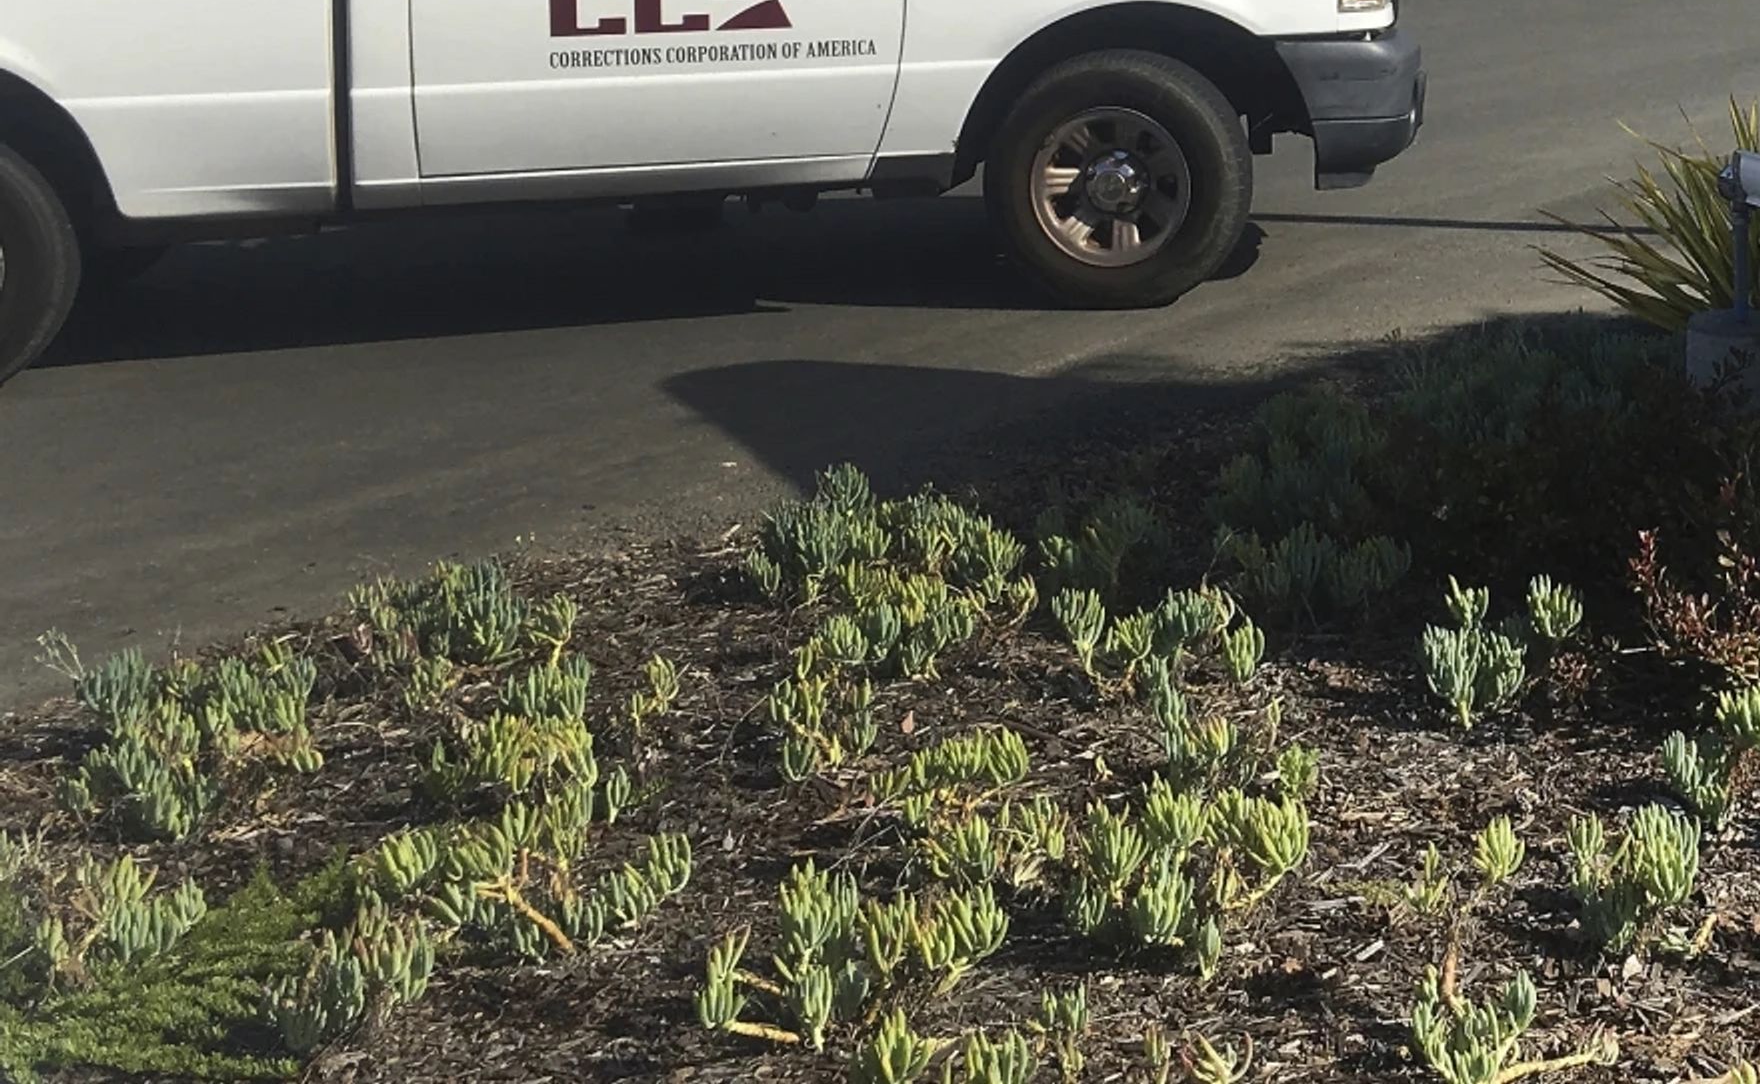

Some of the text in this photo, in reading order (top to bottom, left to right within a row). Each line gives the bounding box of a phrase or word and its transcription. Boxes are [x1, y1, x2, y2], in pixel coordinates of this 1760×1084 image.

[549, 39, 877, 69] CORRECTIONS CORPORATION OF AMERICA
